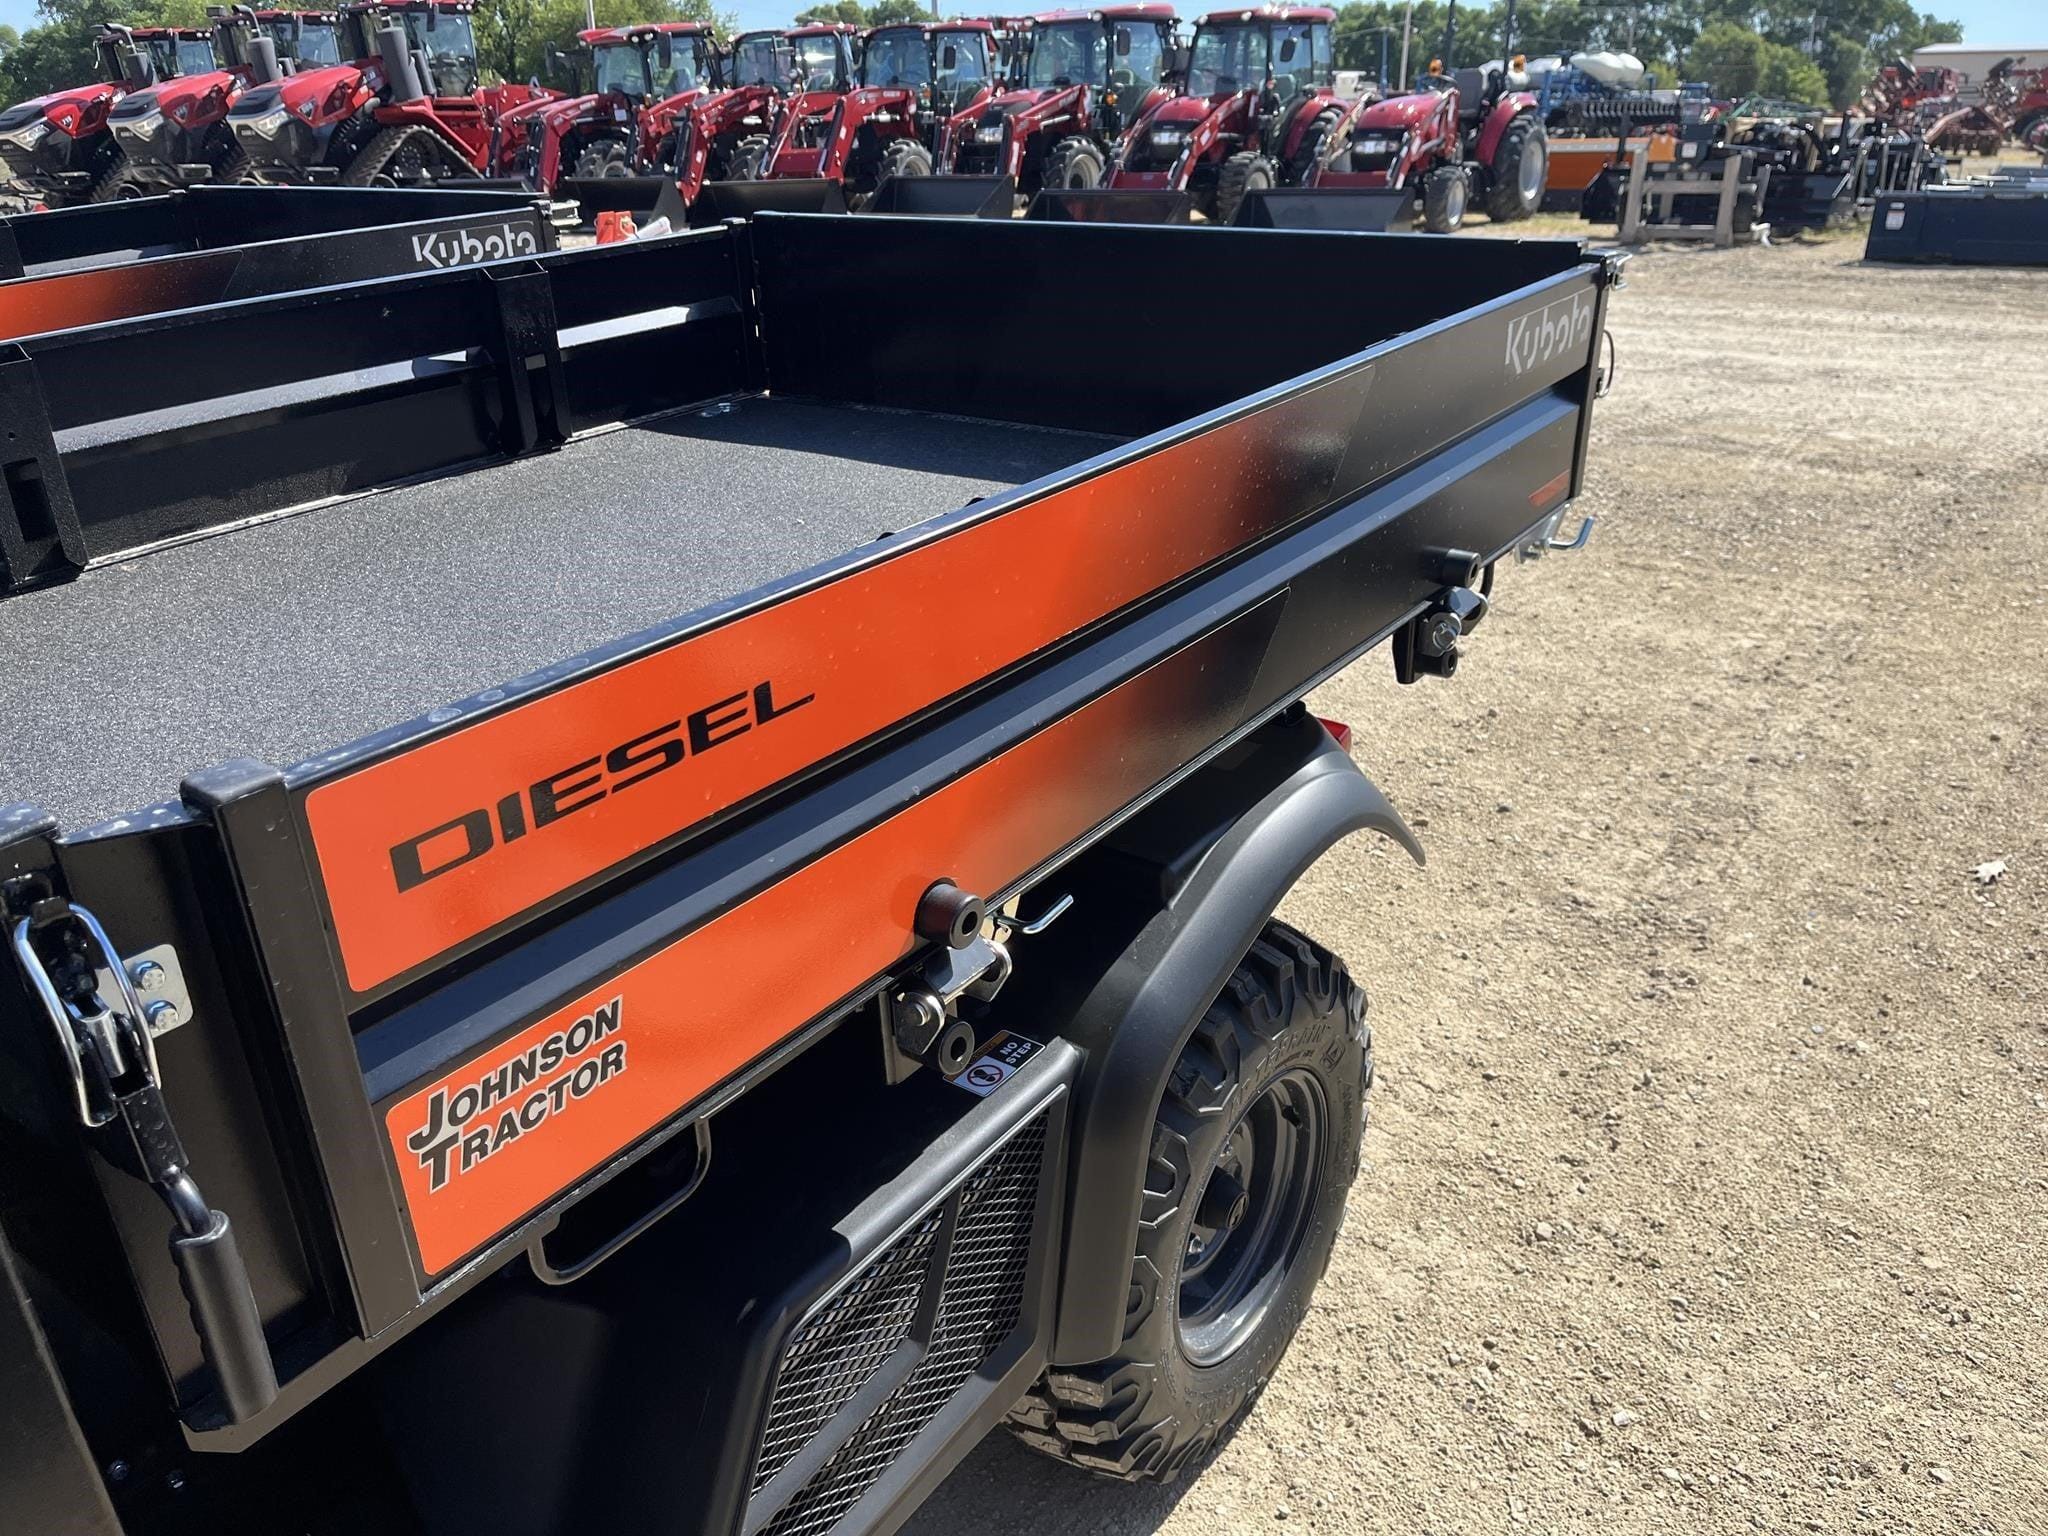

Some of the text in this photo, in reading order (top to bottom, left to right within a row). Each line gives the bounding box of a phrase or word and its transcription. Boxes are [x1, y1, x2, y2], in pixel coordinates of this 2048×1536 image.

[411, 223, 537, 268] Kubota
[1504, 293, 1591, 375] Kubota
[388, 680, 816, 894] DIESEL
[407, 995, 623, 1153] JOHNSON
[999, 1041, 1018, 1055] NO
[1005, 1042, 1032, 1064] STEP
[419, 1040, 627, 1194] TRACTOR
